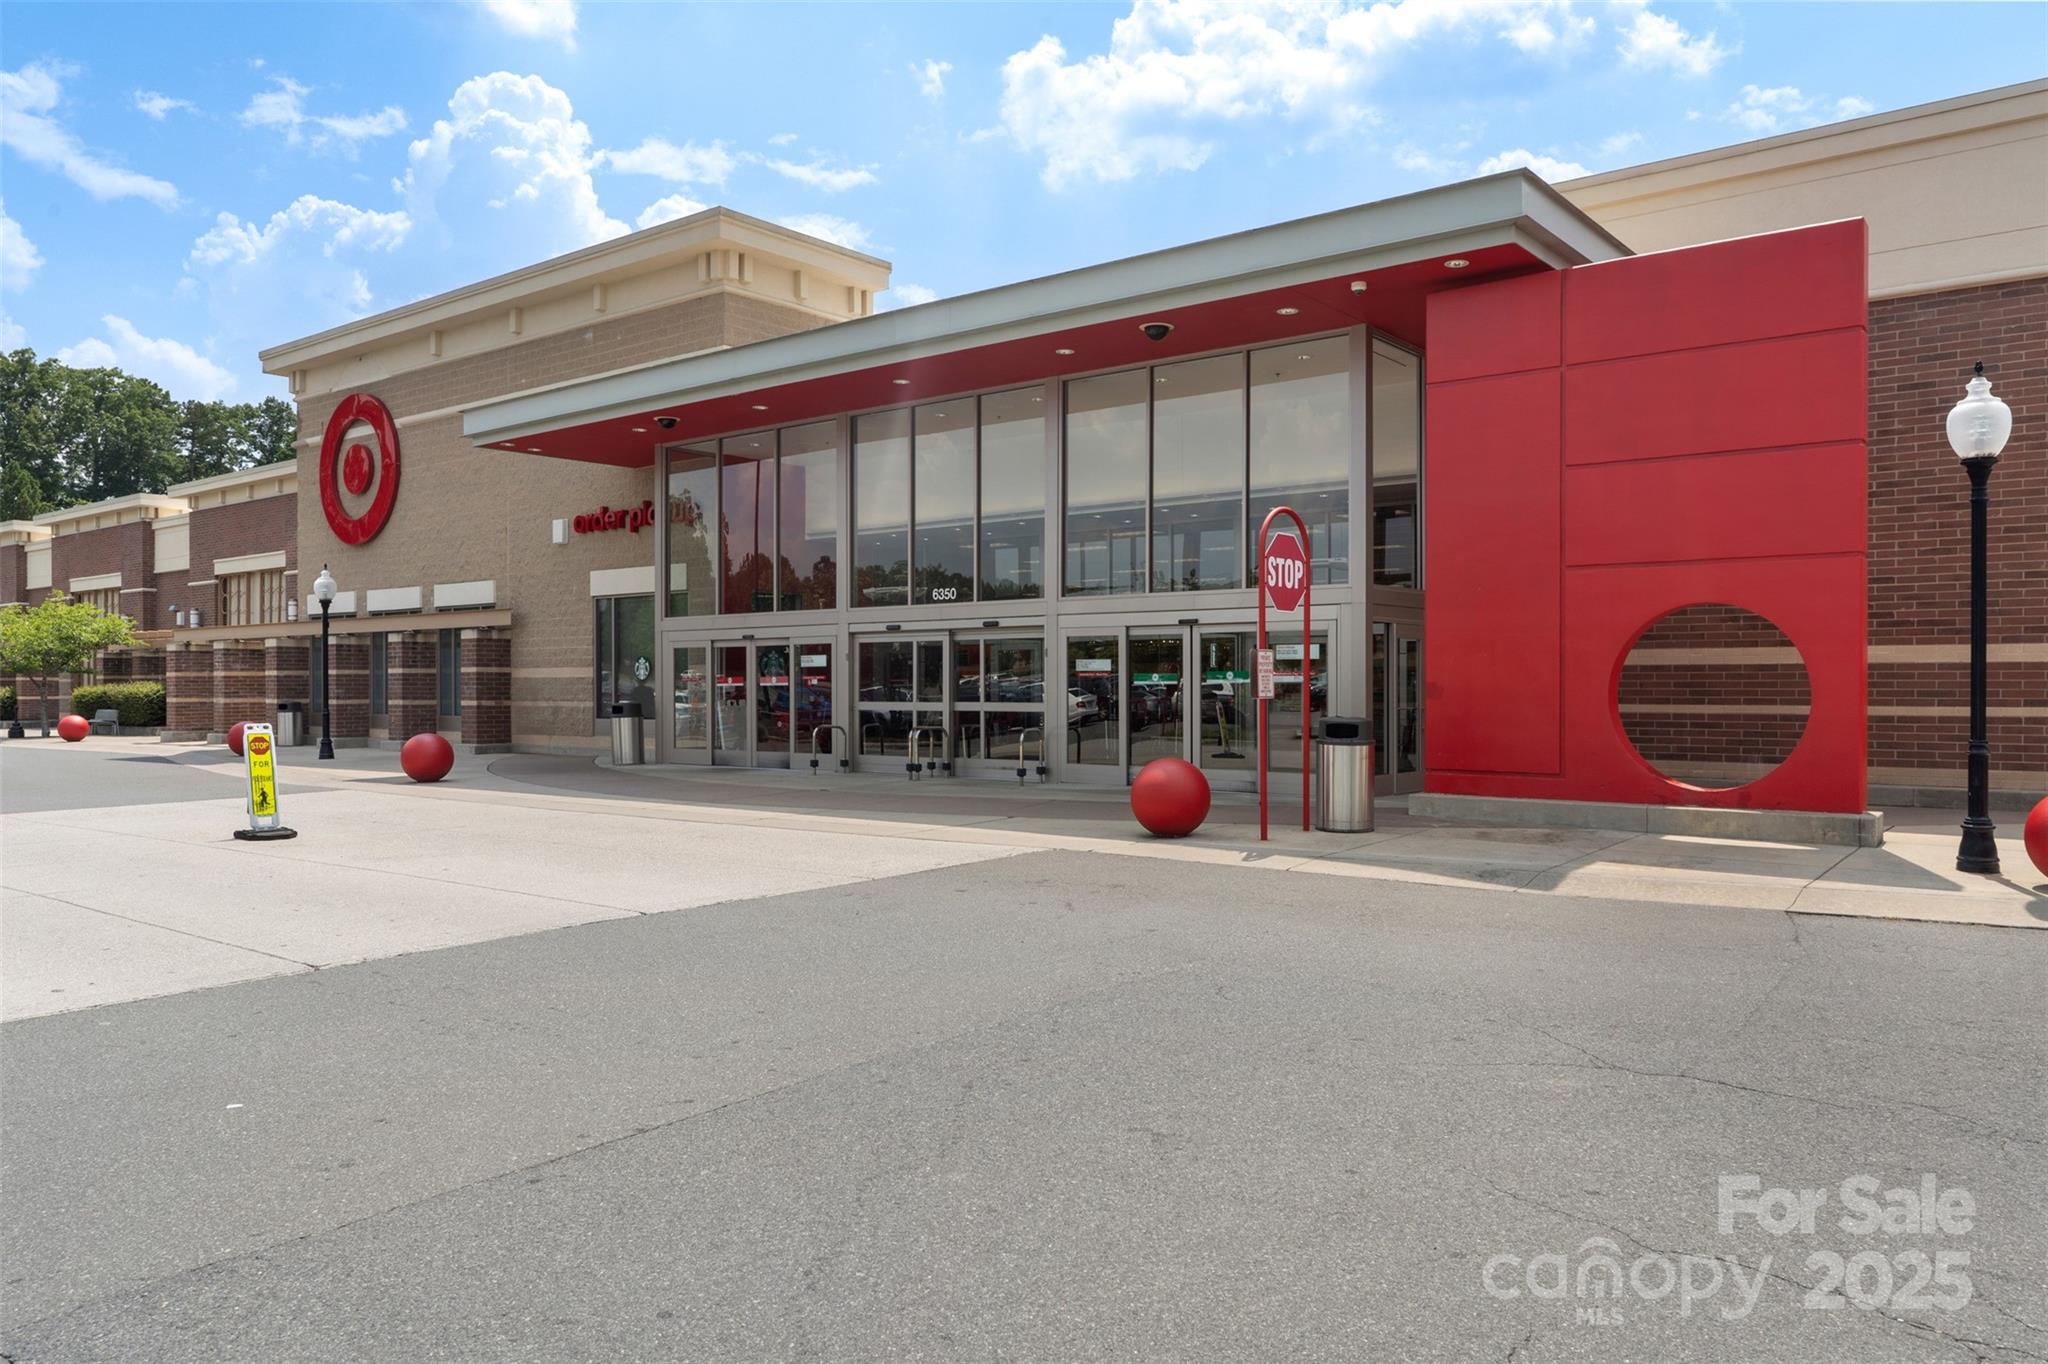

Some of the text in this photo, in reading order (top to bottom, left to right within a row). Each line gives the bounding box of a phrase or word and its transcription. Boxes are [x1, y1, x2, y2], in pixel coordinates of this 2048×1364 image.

[573, 506, 628, 534] order
[1267, 555, 1304, 590] STOP
[932, 587, 957, 601] 6350
[250, 742, 269, 750] STOP
[253, 760, 270, 768] FOR
